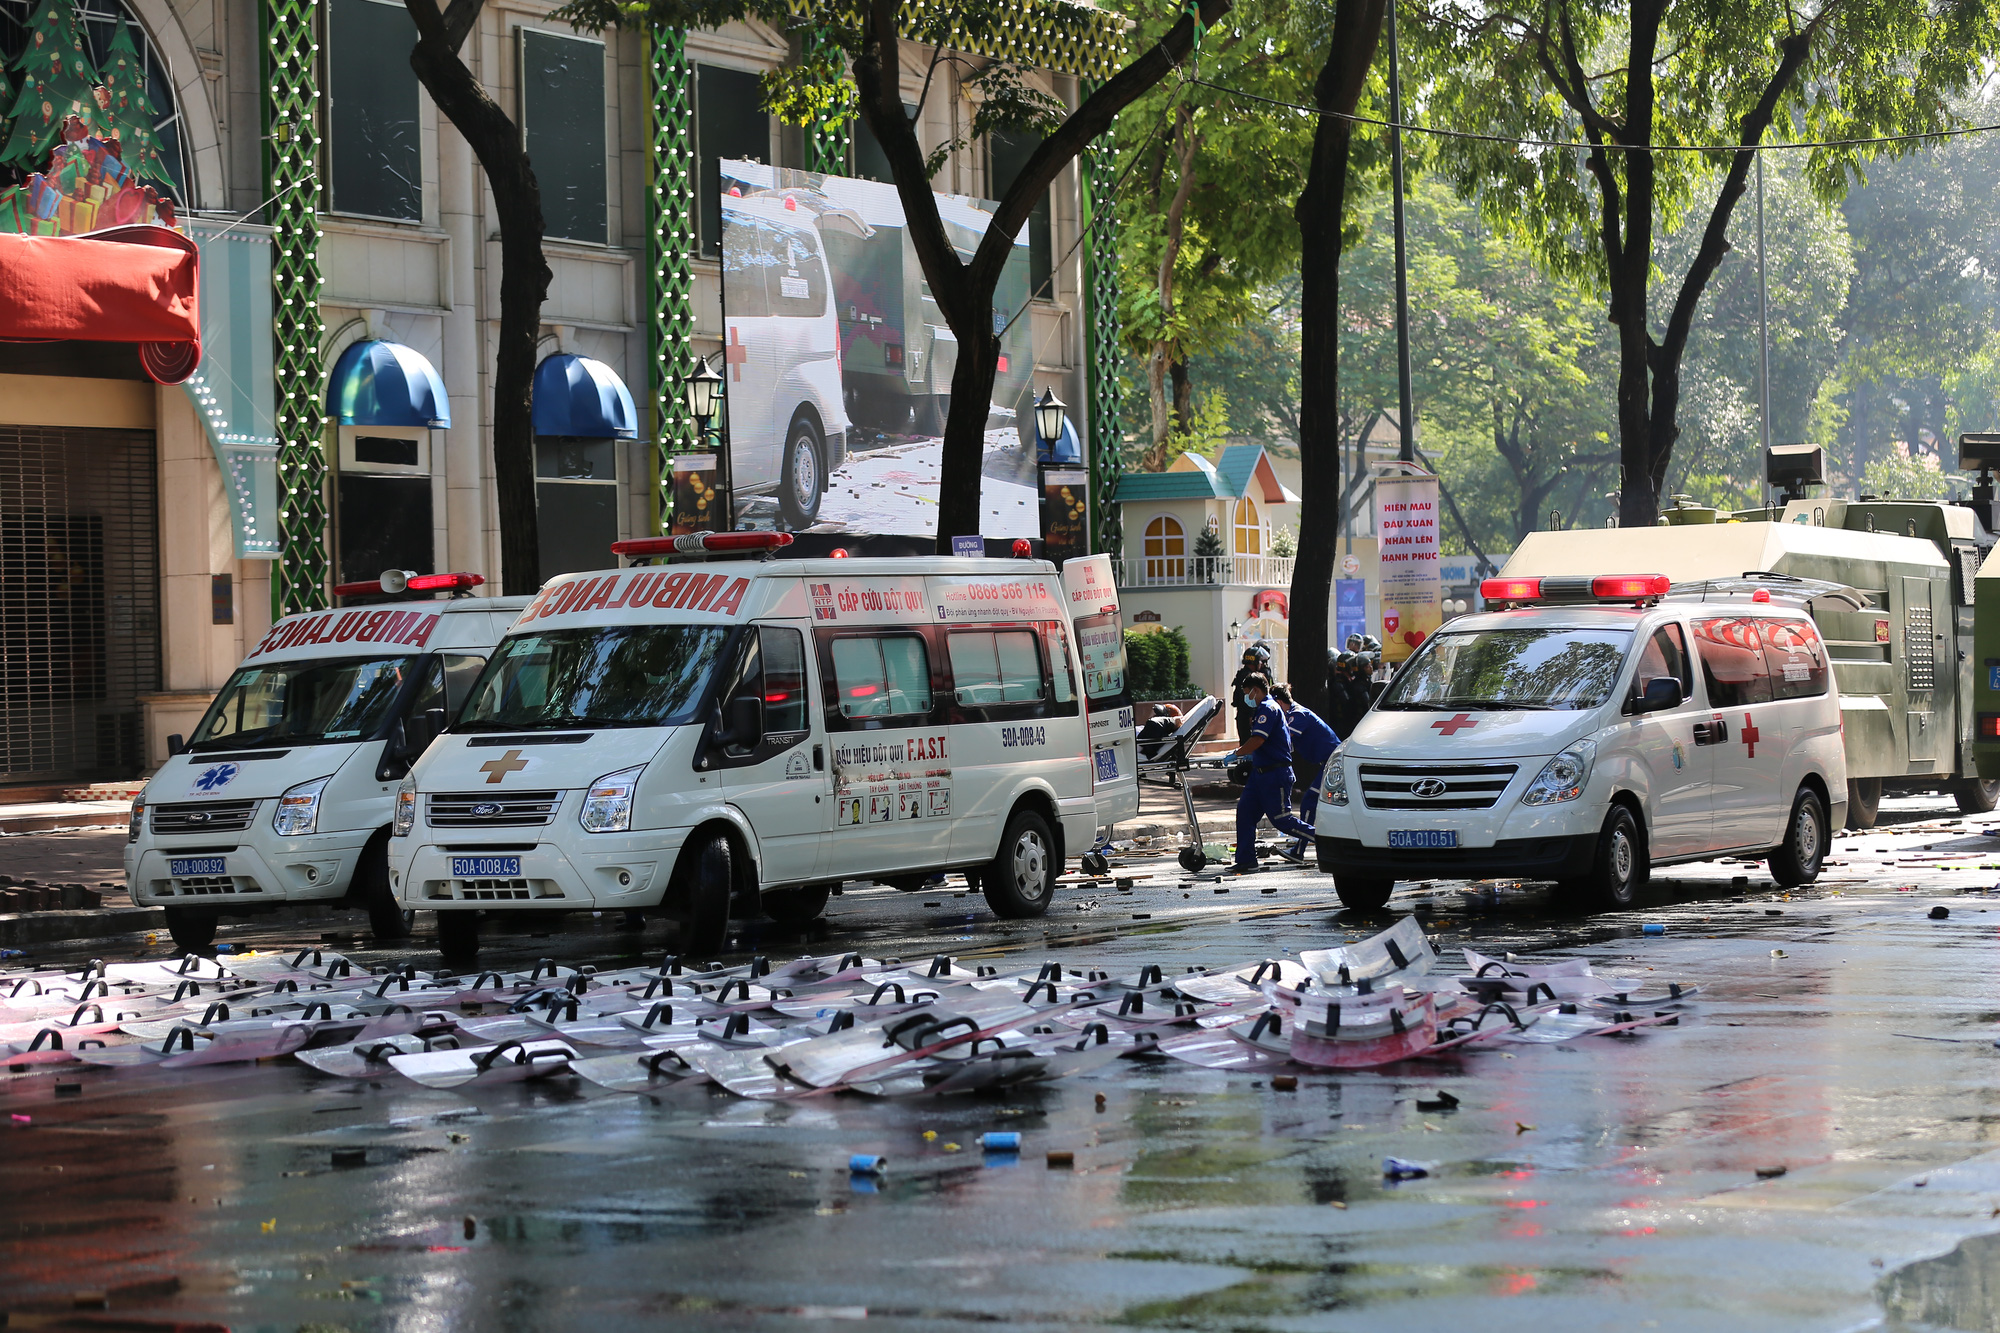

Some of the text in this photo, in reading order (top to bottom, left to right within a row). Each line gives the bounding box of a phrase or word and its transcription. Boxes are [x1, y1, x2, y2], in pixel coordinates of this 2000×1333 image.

[837, 585, 859, 612] CẤP
[861, 588, 883, 611] CỨU
[945, 582, 1047, 601] Hotline 0868 566 115
[815, 598, 832, 606] NTP
[766, 736, 794, 745] TRANSIT
[1002, 726, 1046, 747] 50A-008.43
[853, 744, 871, 767] HIỆU
[1390, 832, 1453, 846] 50A-010.51
[172, 859, 224, 874] 50A-008.92
[454, 858, 518, 875] 50A-008.43
